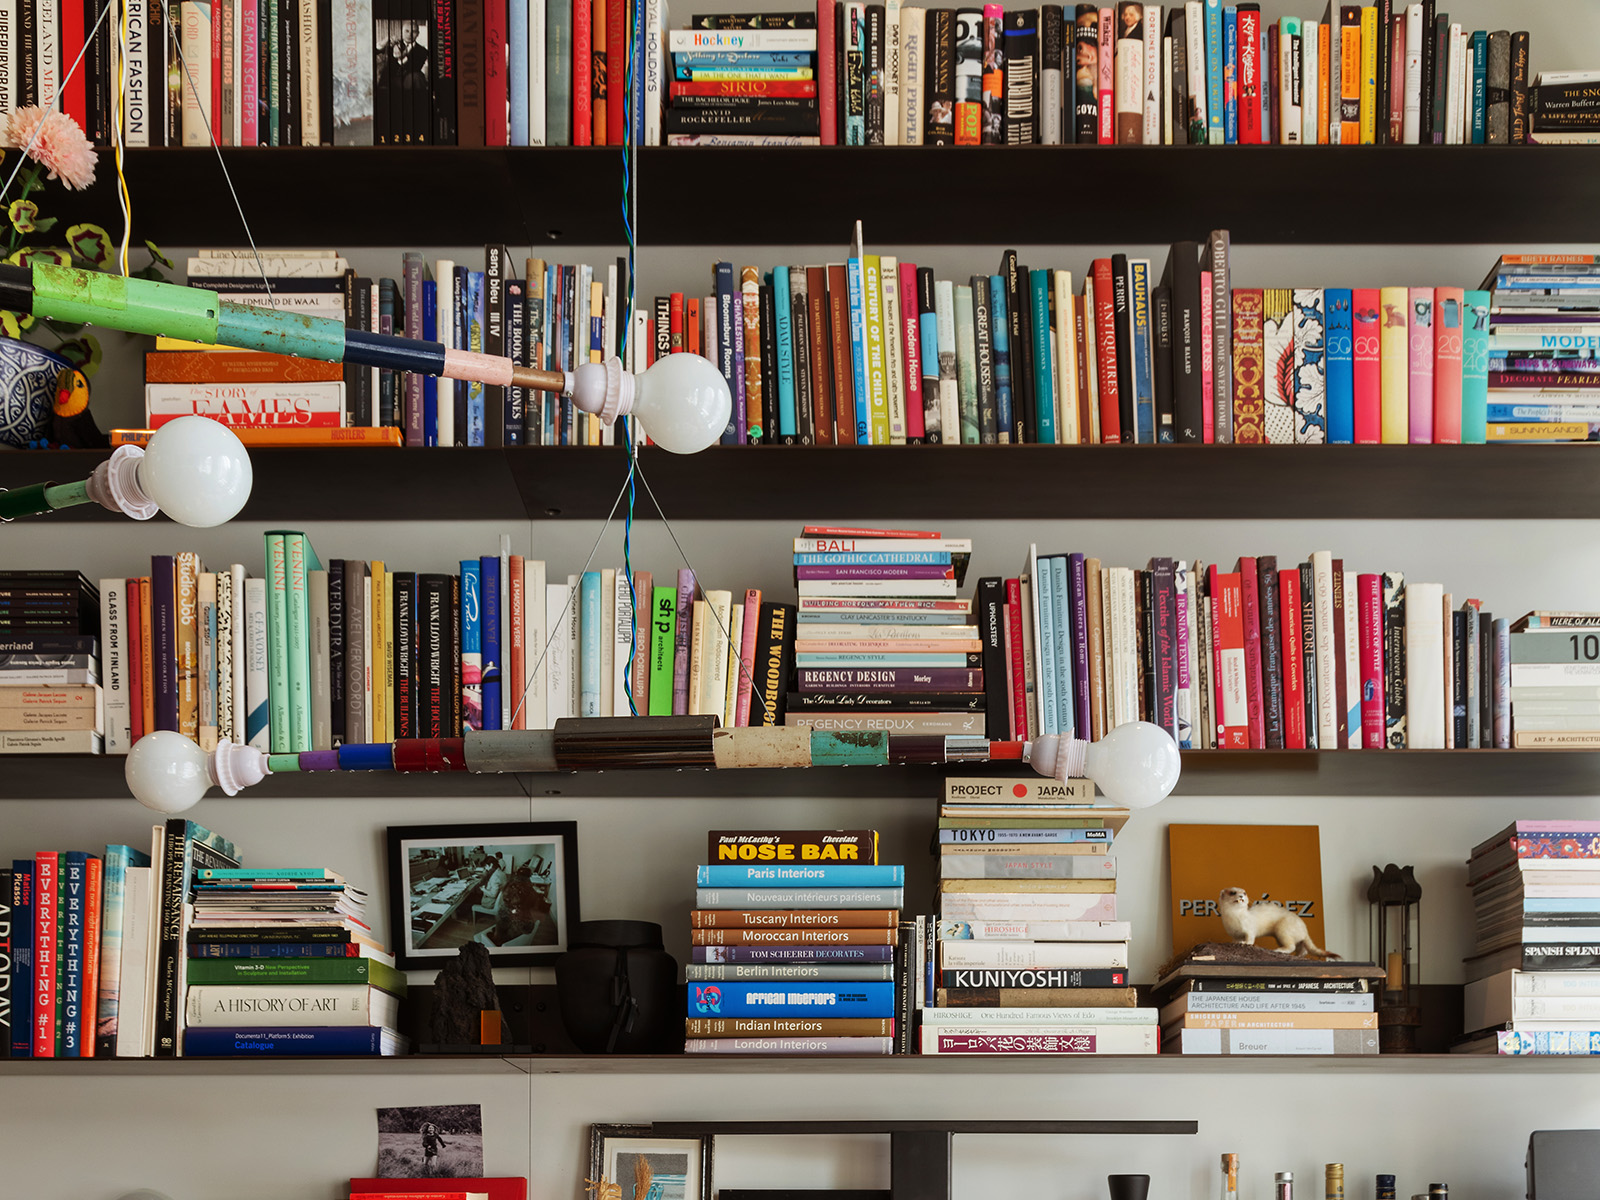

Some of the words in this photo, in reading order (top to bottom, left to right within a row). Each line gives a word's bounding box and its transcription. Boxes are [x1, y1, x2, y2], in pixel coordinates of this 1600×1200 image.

[243, 10, 255, 66] SEAMAN
[694, 33, 744, 47] Hockney
[1210, 13, 1218, 54] HEAVEN
[648, 32, 658, 92] HOLIDAYS
[905, 34, 918, 83] RIGHT
[1210, 56, 1218, 68] ON
[129, 60, 143, 133] FASHION
[243, 67, 255, 124] SCHEPPS
[721, 81, 767, 93] SIRIO
[1007, 55, 1033, 118] CHURCHILL
[1210, 70, 1218, 111] EARTH
[905, 88, 919, 144] PEOPLE
[1076, 104, 1097, 116] GOYA
[1571, 99, 1595, 107] Buffett
[966, 103, 977, 137] POP
[487, 248, 500, 277] sang
[490, 278, 500, 304] bleu
[867, 267, 879, 323] CENTURY
[1116, 275, 1125, 313] PERRIN
[1133, 264, 1147, 327] BAUHAUS
[721, 294, 732, 346] Bloomsbury
[735, 299, 743, 352] CHARLESTON
[779, 314, 791, 347] ADAM
[870, 326, 880, 341] OF
[977, 305, 989, 342] GREAT
[907, 318, 917, 357] Modern
[1103, 301, 1118, 396] ANTIQUAIRES
[1327, 336, 1352, 355] 50
[1354, 336, 1379, 355] 60
[722, 347, 733, 379] Rooms
[780, 349, 792, 385] STYLE
[871, 345, 881, 367] THE
[979, 343, 991, 385] HOUSES
[872, 371, 883, 406] CHILD
[908, 359, 919, 391] House
[205, 388, 248, 398] STORY
[190, 398, 312, 425] EAMES
[331, 429, 366, 441] HUSTLERS
[802, 554, 825, 564] THE
[825, 553, 867, 564] GOTHIC
[869, 553, 935, 563] CATHEDRAL
[816, 540, 856, 552] BALI
[180, 552, 194, 596] Studio
[292, 540, 303, 591] VENINI
[108, 591, 117, 620] GLASS
[180, 598, 192, 625] Job
[329, 580, 341, 659] VERDURA
[350, 607, 361, 634] AXEL
[1159, 587, 1170, 627] Textiles
[1177, 598, 1187, 639] IRANIAN
[110, 622, 118, 649] FROM
[636, 627, 645, 652] PIERO
[989, 602, 998, 647] UPHOLSTERY
[1161, 628, 1171, 639] of
[1303, 601, 1314, 654] SHIBORI
[656, 635, 664, 671] architects
[1162, 640, 1171, 654] the
[1392, 625, 1403, 675] Interwoven
[111, 651, 120, 691] FINLAND
[351, 640, 361, 716] VERVOORDT
[636, 653, 645, 697] PORTALUPPI
[805, 671, 853, 682] REGENCY
[857, 671, 896, 682] DESIGN
[1161, 656, 1172, 694] Islamic
[1178, 642, 1188, 685] TEXTILES
[1392, 678, 1403, 706] Globe
[867, 719, 915, 730] REDUX
[1162, 695, 1173, 727] World
[951, 785, 1003, 796] PROJECT
[1037, 786, 1075, 797] JAPAN
[951, 829, 996, 842] TOKYO
[718, 843, 796, 860] NOSE
[801, 844, 859, 860] BAR
[747, 868, 775, 879] Paris
[777, 868, 825, 879] Interiors
[13, 873, 22, 907] Picasso
[22, 873, 31, 906] Matisse
[169, 861, 183, 940] RENAISSANCE
[747, 892, 793, 902] Nouveaux
[794, 892, 838, 903] intérieurs
[839, 893, 881, 904] parisiens
[742, 913, 788, 927] Tuscany
[790, 914, 838, 926] Interiors
[742, 931, 799, 941] Moroccan
[801, 931, 849, 941] Interiors
[750, 950, 768, 958] TOM
[769, 950, 814, 958] SCHEERER
[815, 950, 864, 958] DECORATES
[1525, 946, 1564, 957] SPANISH
[736, 966, 770, 976] Berlin
[772, 966, 819, 977] Interiors
[955, 970, 1068, 988] KUNIYOSHI
[214, 999, 226, 1012] A
[229, 998, 286, 1012] HISTORY
[288, 998, 308, 1012] OF
[310, 998, 339, 1012] ART
[735, 1020, 771, 1032] Indian
[773, 1021, 822, 1032] Interiors
[234, 1041, 274, 1050] Catalogue
[734, 1039, 777, 1050] London
[779, 1040, 827, 1051] Interiors
[1238, 1042, 1268, 1051] Breuer
